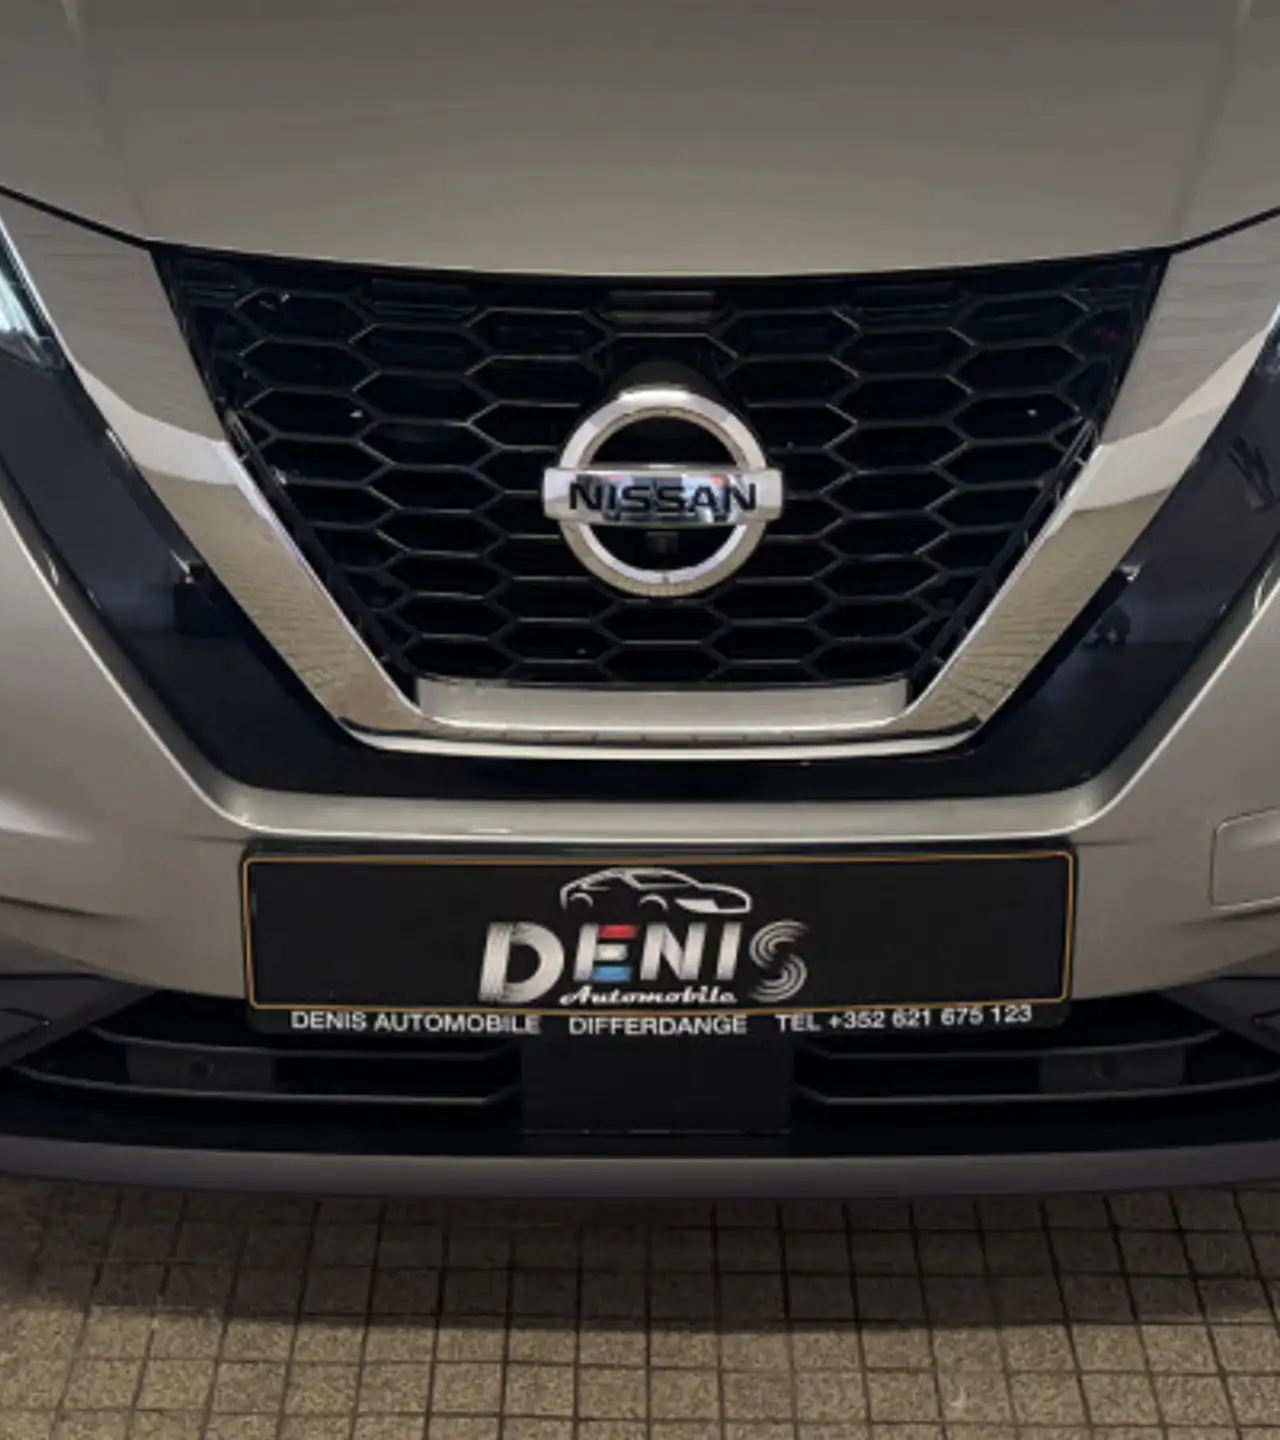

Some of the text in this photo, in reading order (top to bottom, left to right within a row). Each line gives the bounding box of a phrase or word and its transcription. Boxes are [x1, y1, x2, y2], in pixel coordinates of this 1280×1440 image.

[568, 481, 758, 512] NISSAN
[477, 920, 810, 1003] DENIS
[558, 984, 738, 1006] Automobile
[290, 1010, 368, 1032] DENIS
[372, 1012, 542, 1035] AUTOMOBILE
[567, 1014, 748, 1037] DIFFERDANGE
[774, 1013, 821, 1033] TEL
[827, 1010, 885, 1030] +352
[891, 1008, 933, 1029] 621
[991, 1004, 1033, 1024] 123
